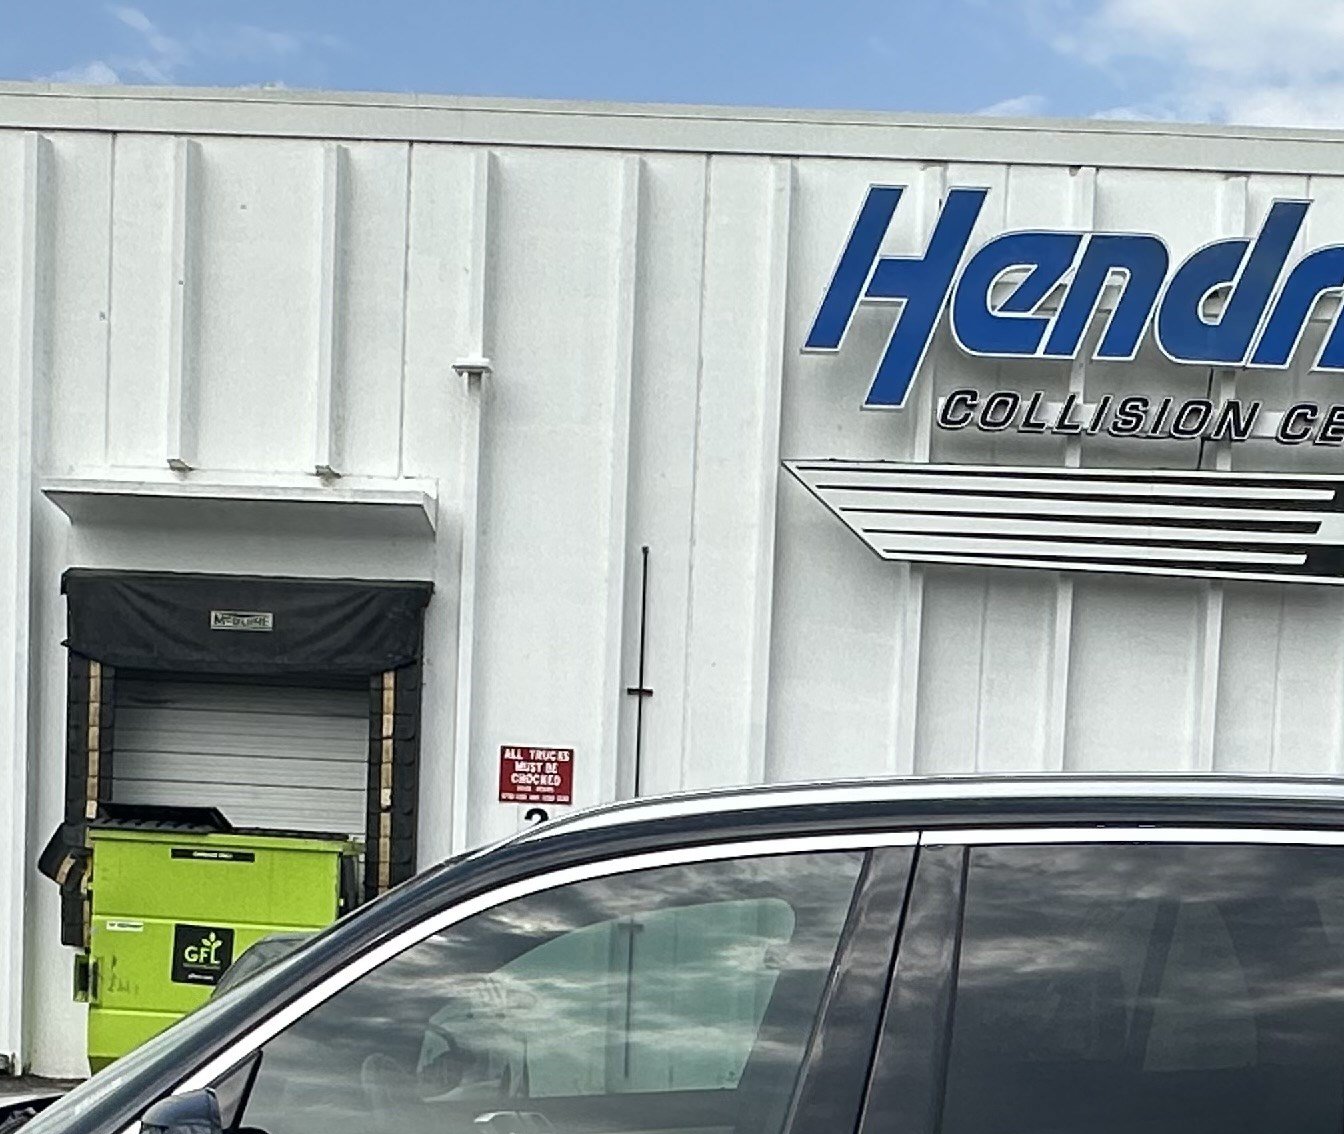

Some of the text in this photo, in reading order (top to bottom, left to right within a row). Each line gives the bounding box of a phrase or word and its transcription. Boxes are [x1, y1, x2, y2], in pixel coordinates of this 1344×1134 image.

[936, 387, 1269, 442] COLLISION
[504, 748, 524, 760] ALL
[515, 760, 543, 773] MUST
[183, 941, 222, 964] GFL
